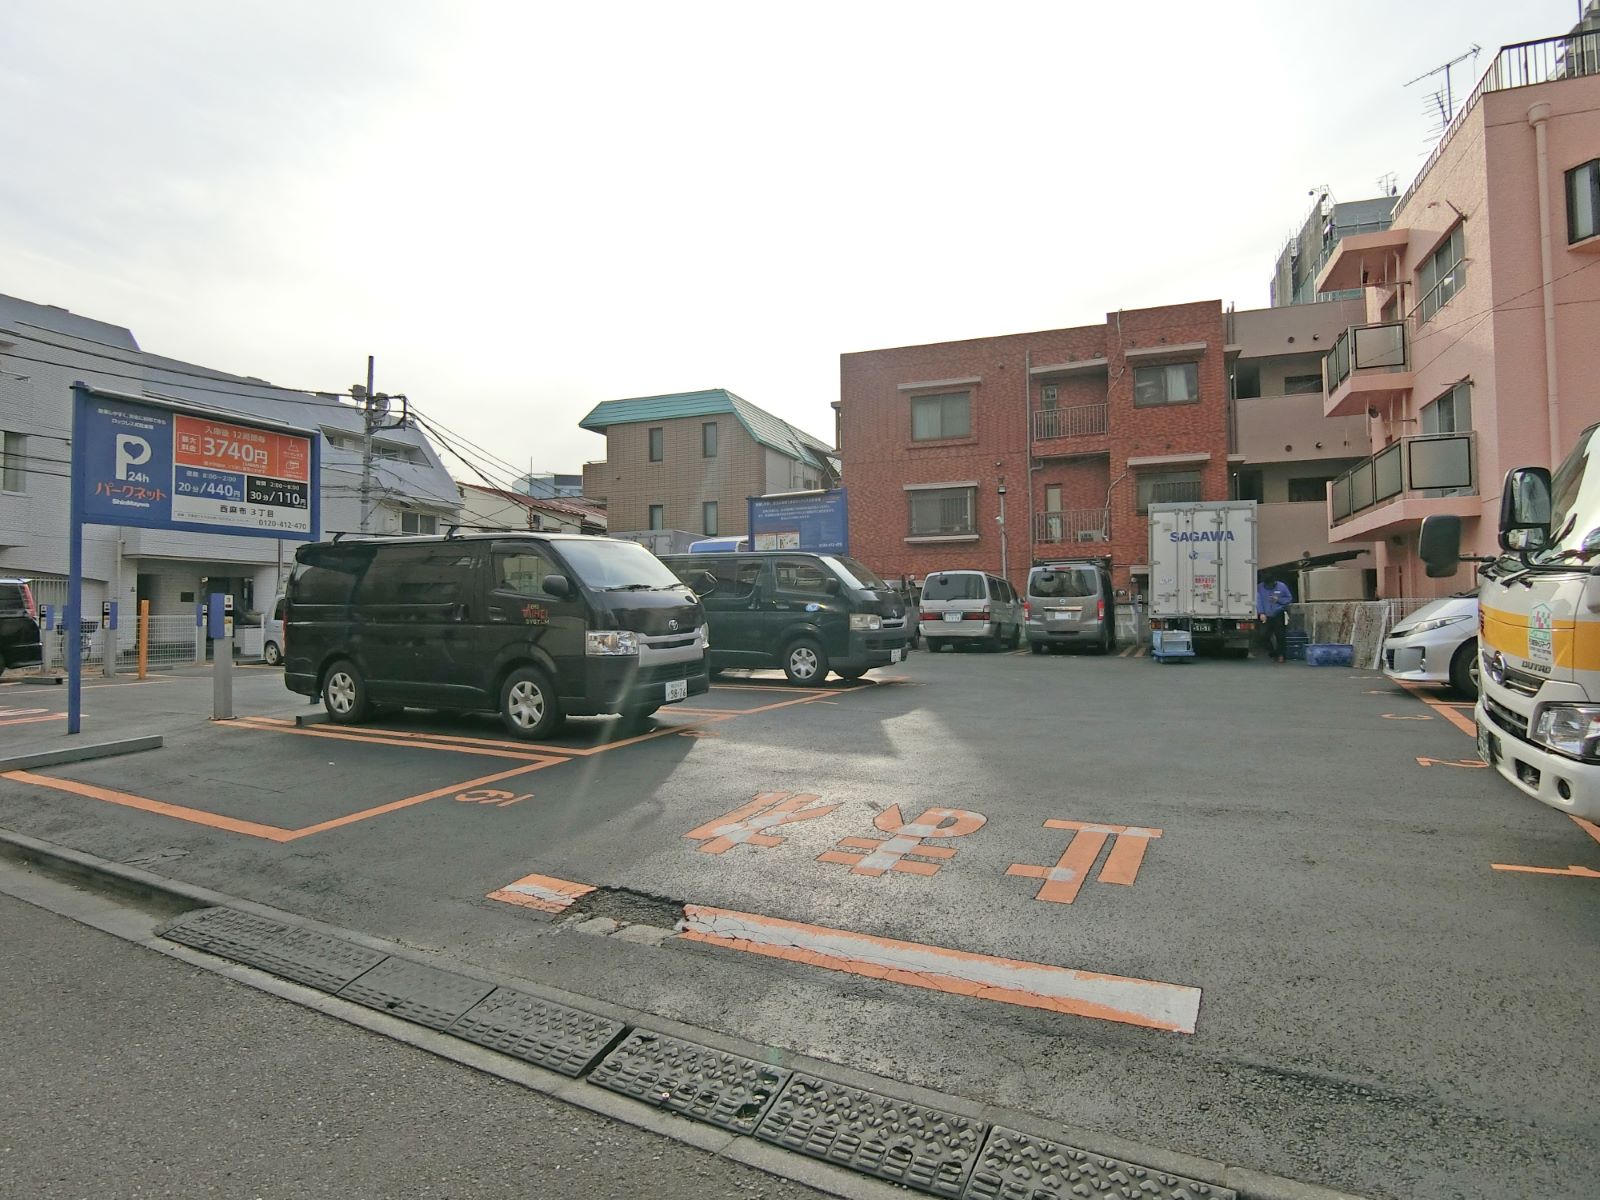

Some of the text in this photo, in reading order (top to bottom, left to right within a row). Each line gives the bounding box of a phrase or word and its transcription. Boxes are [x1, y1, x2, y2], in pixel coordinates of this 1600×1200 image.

[203, 437, 268, 465] 3740円
[128, 471, 150, 484] 24h
[96, 482, 167, 501] パークネット
[258, 520, 307, 530] 0120-412-470
[1170, 531, 1235, 543] SAGAWA
